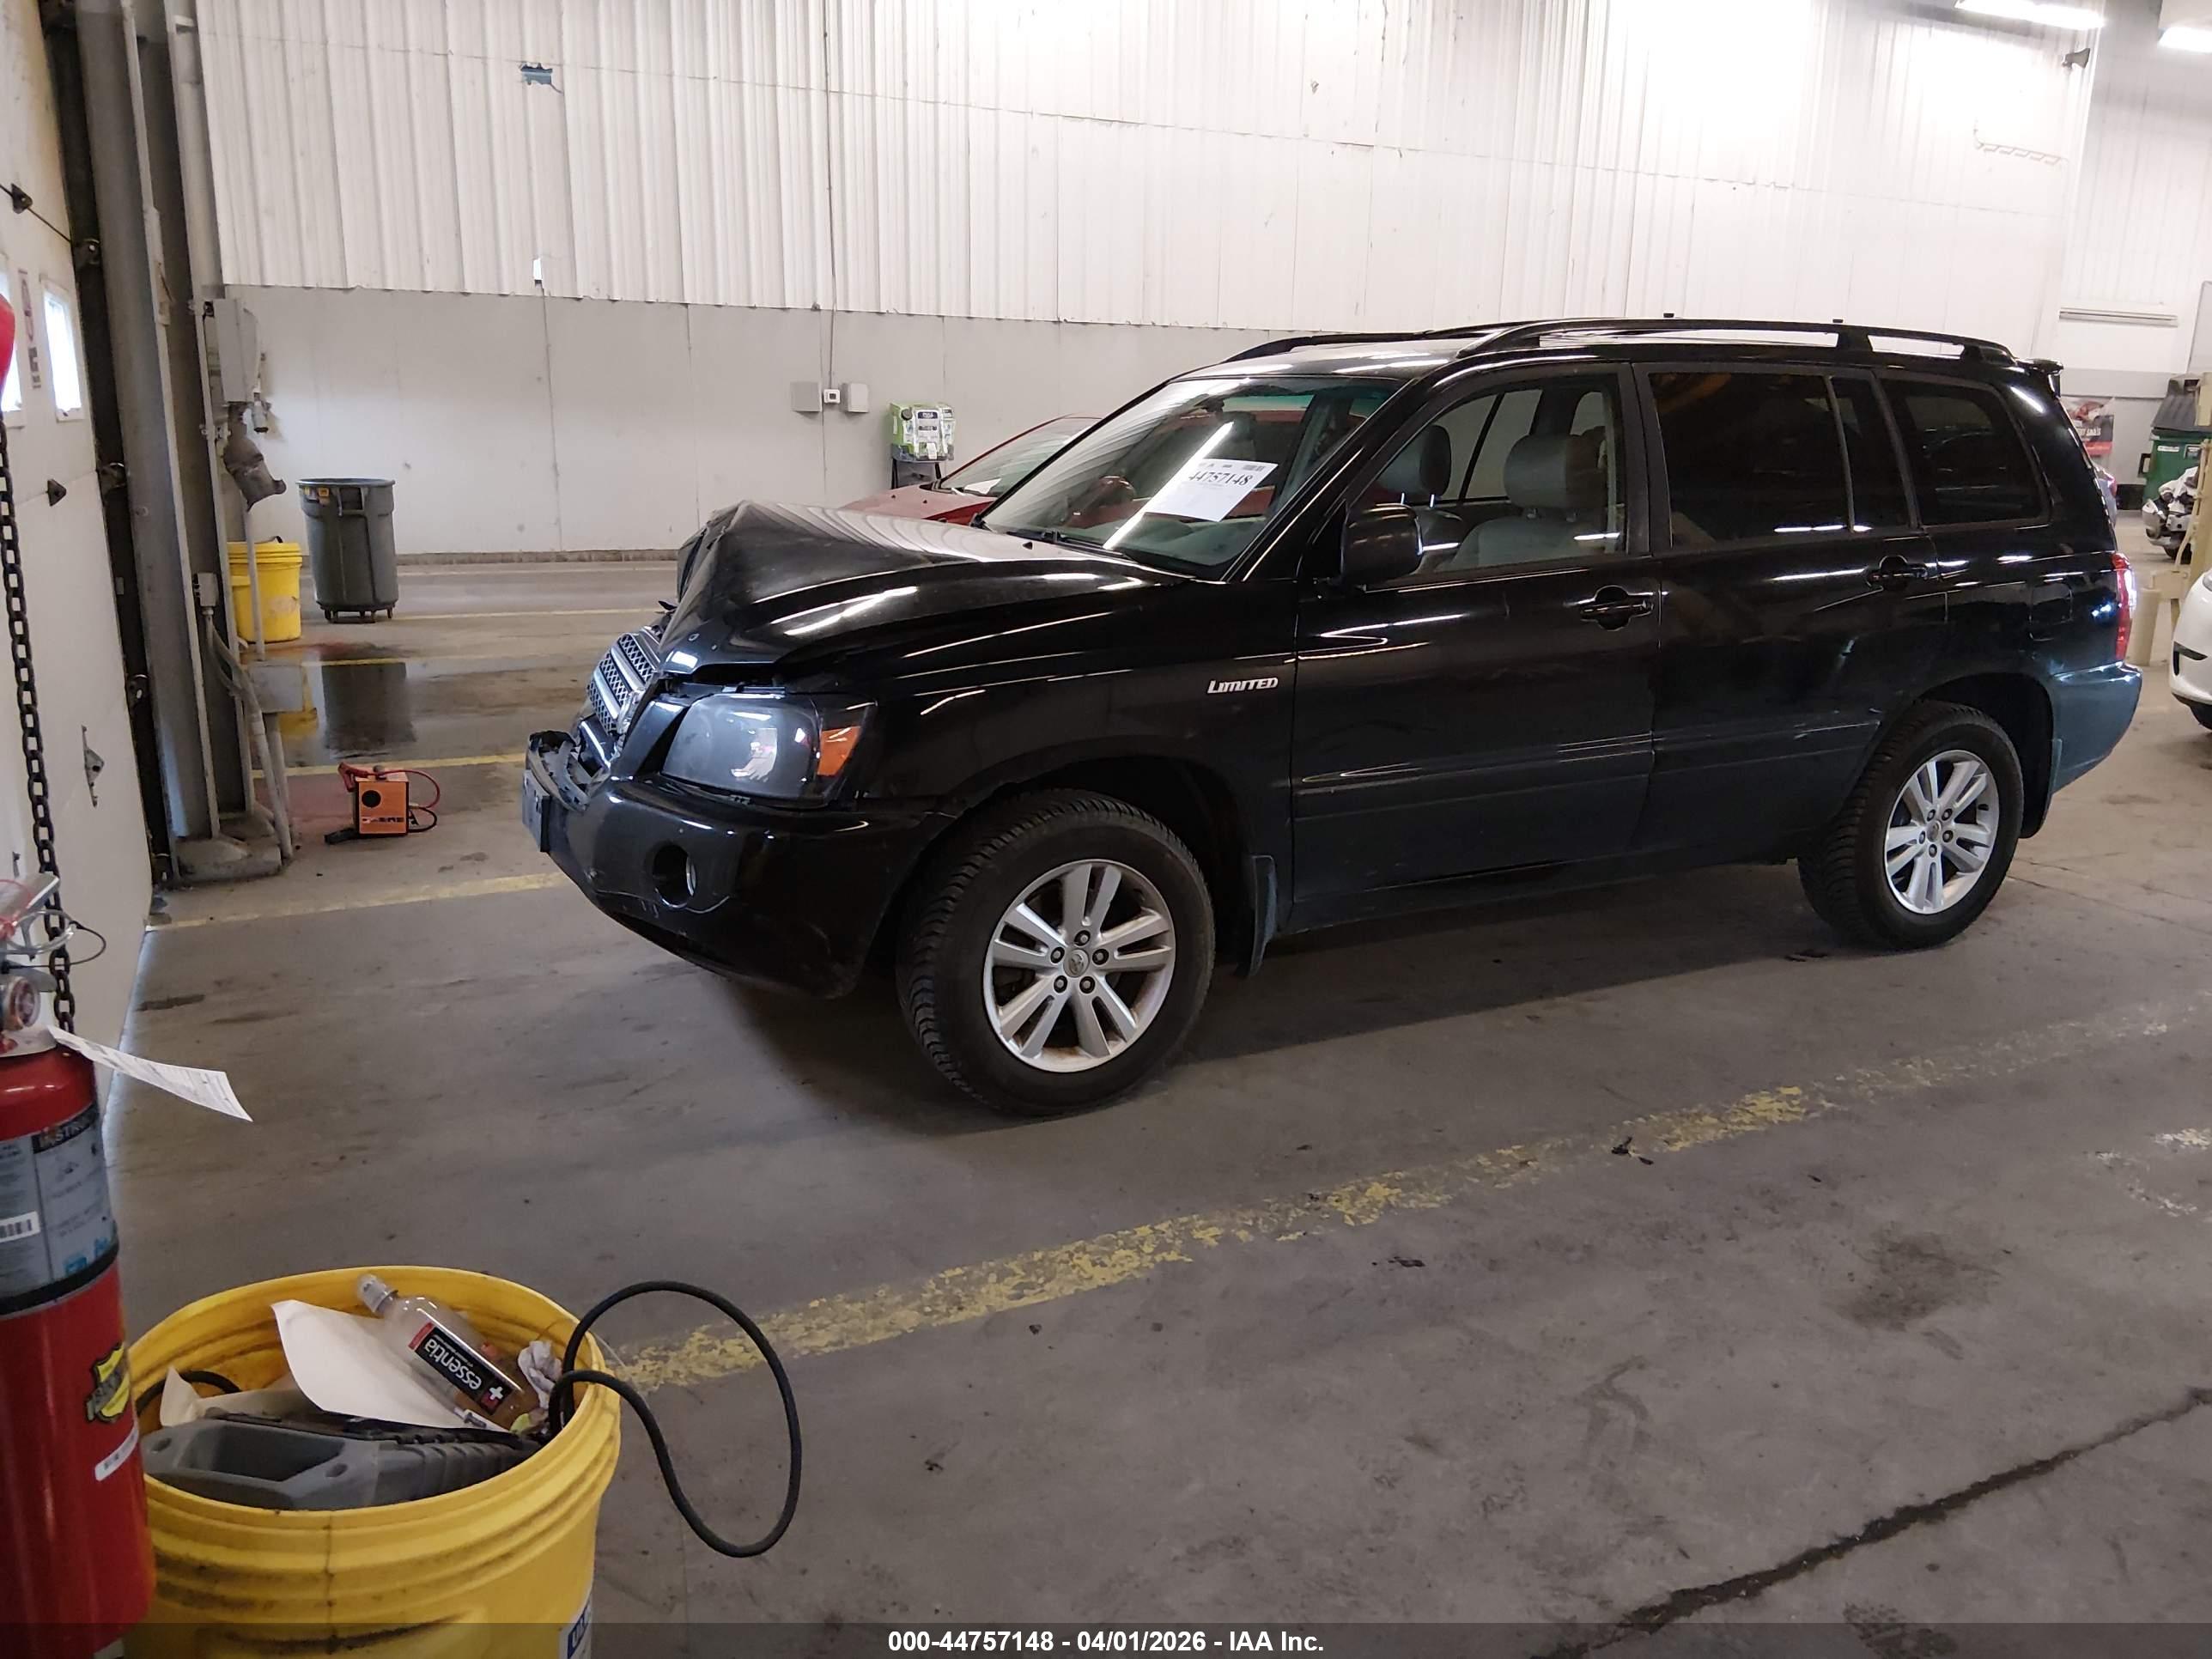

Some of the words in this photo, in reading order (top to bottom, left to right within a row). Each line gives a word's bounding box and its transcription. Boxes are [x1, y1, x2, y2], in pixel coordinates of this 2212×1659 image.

[1188, 471, 1254, 486] 44757148
[1206, 677, 1279, 694] LIMITED
[424, 1338, 483, 1390] essentia
